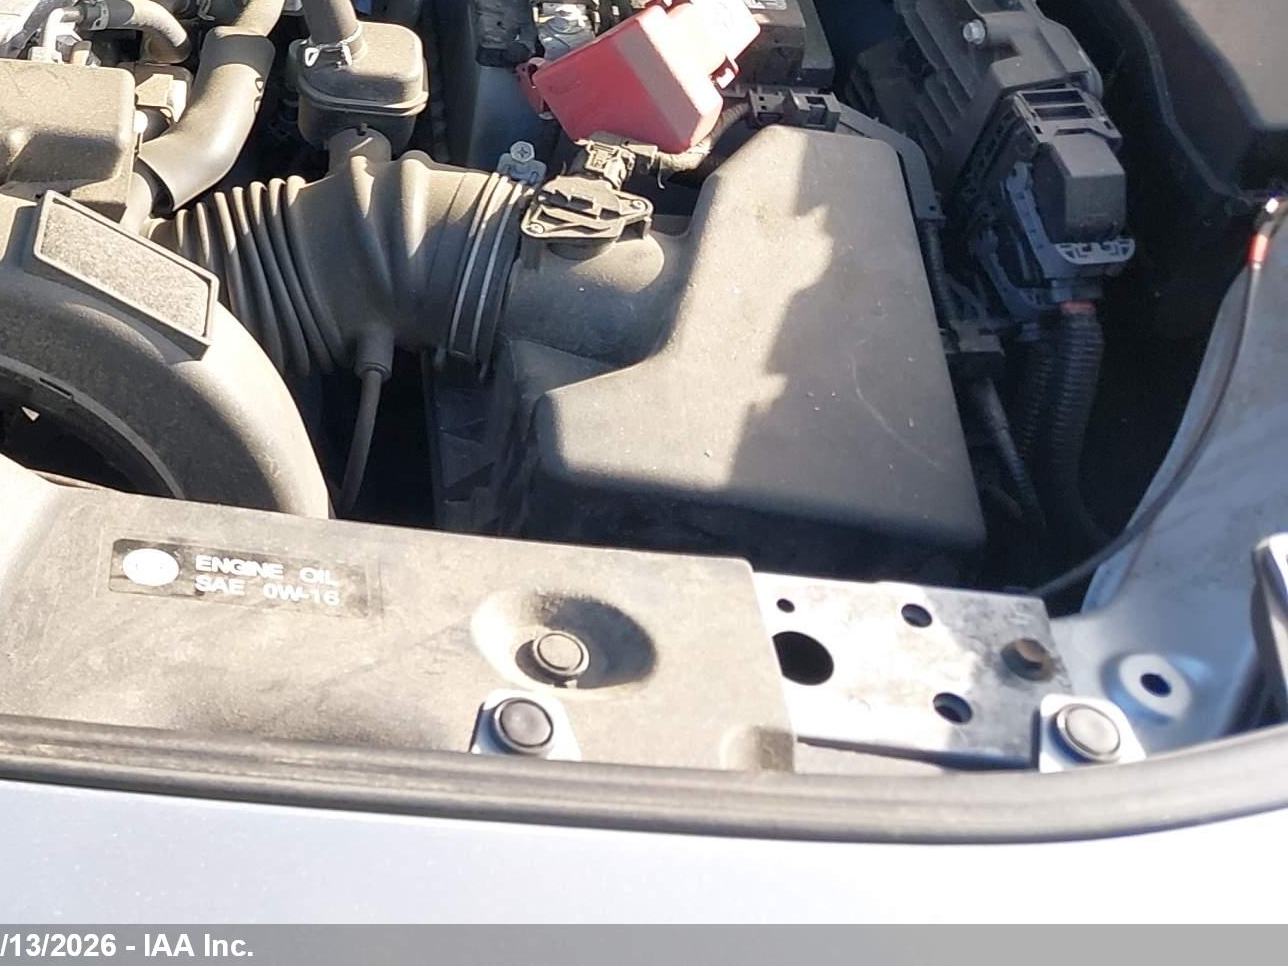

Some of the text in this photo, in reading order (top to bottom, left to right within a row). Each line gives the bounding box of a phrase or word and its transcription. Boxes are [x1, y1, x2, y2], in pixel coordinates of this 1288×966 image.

[195, 554, 341, 587] ENGINE OIL
[194, 574, 341, 606] SAE 0W-16
